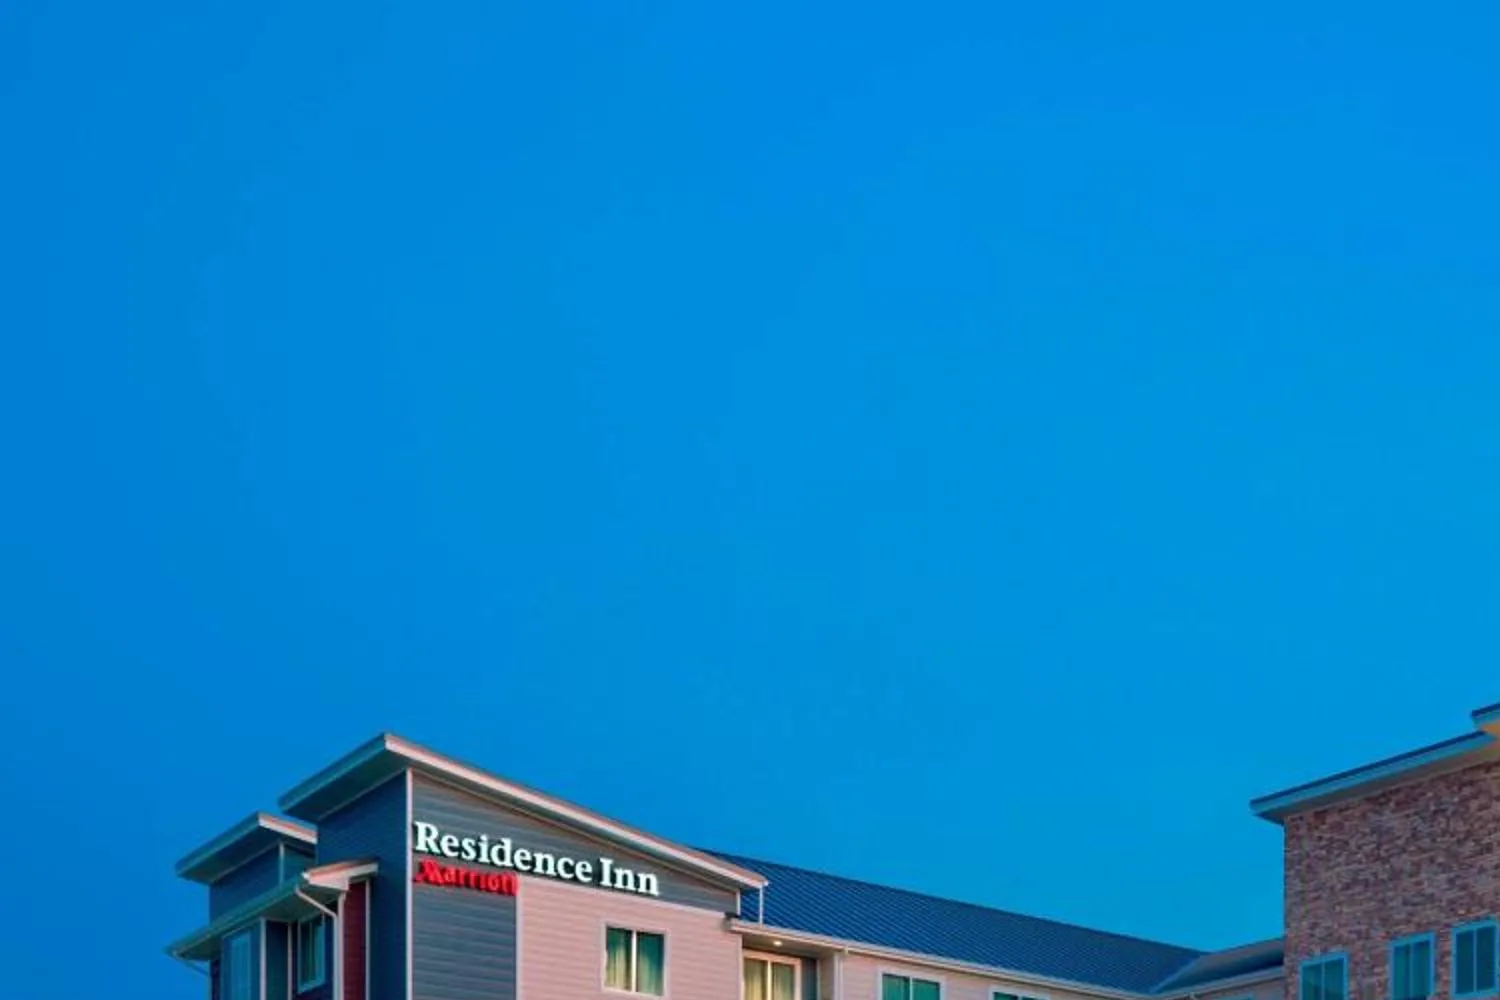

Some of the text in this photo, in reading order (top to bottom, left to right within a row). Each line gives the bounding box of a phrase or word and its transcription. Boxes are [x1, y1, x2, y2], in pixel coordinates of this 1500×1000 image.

[412, 856, 518, 896] Marriott
[414, 821, 659, 896] Residence Inn
